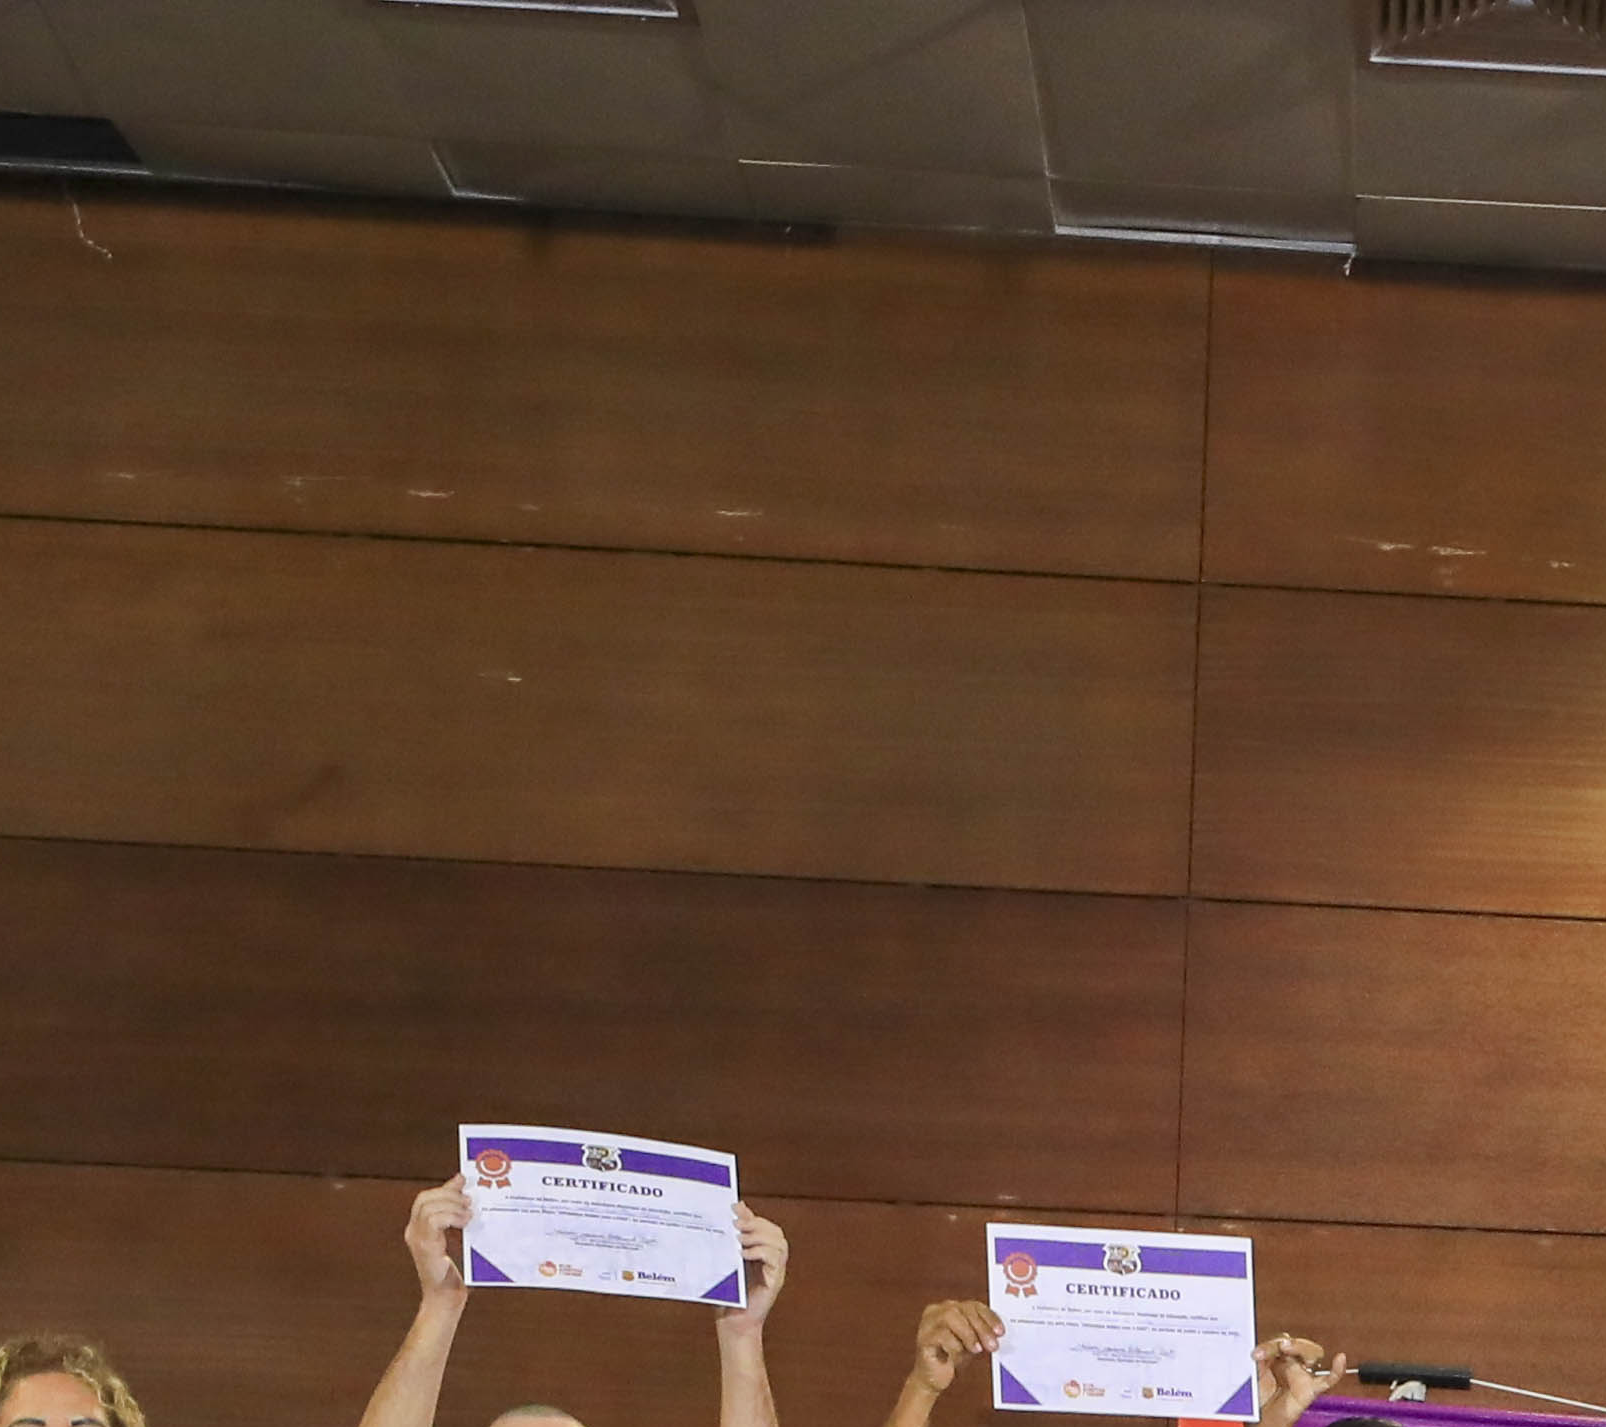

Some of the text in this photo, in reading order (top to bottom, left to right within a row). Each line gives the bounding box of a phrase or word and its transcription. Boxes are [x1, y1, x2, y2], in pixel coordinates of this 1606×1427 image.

[541, 1176, 664, 1198] CERTIFICADO
[637, 1271, 676, 1283] Belém
[1065, 1282, 1181, 1301] CERTIFICADO
[1156, 1387, 1193, 1398] Belém
